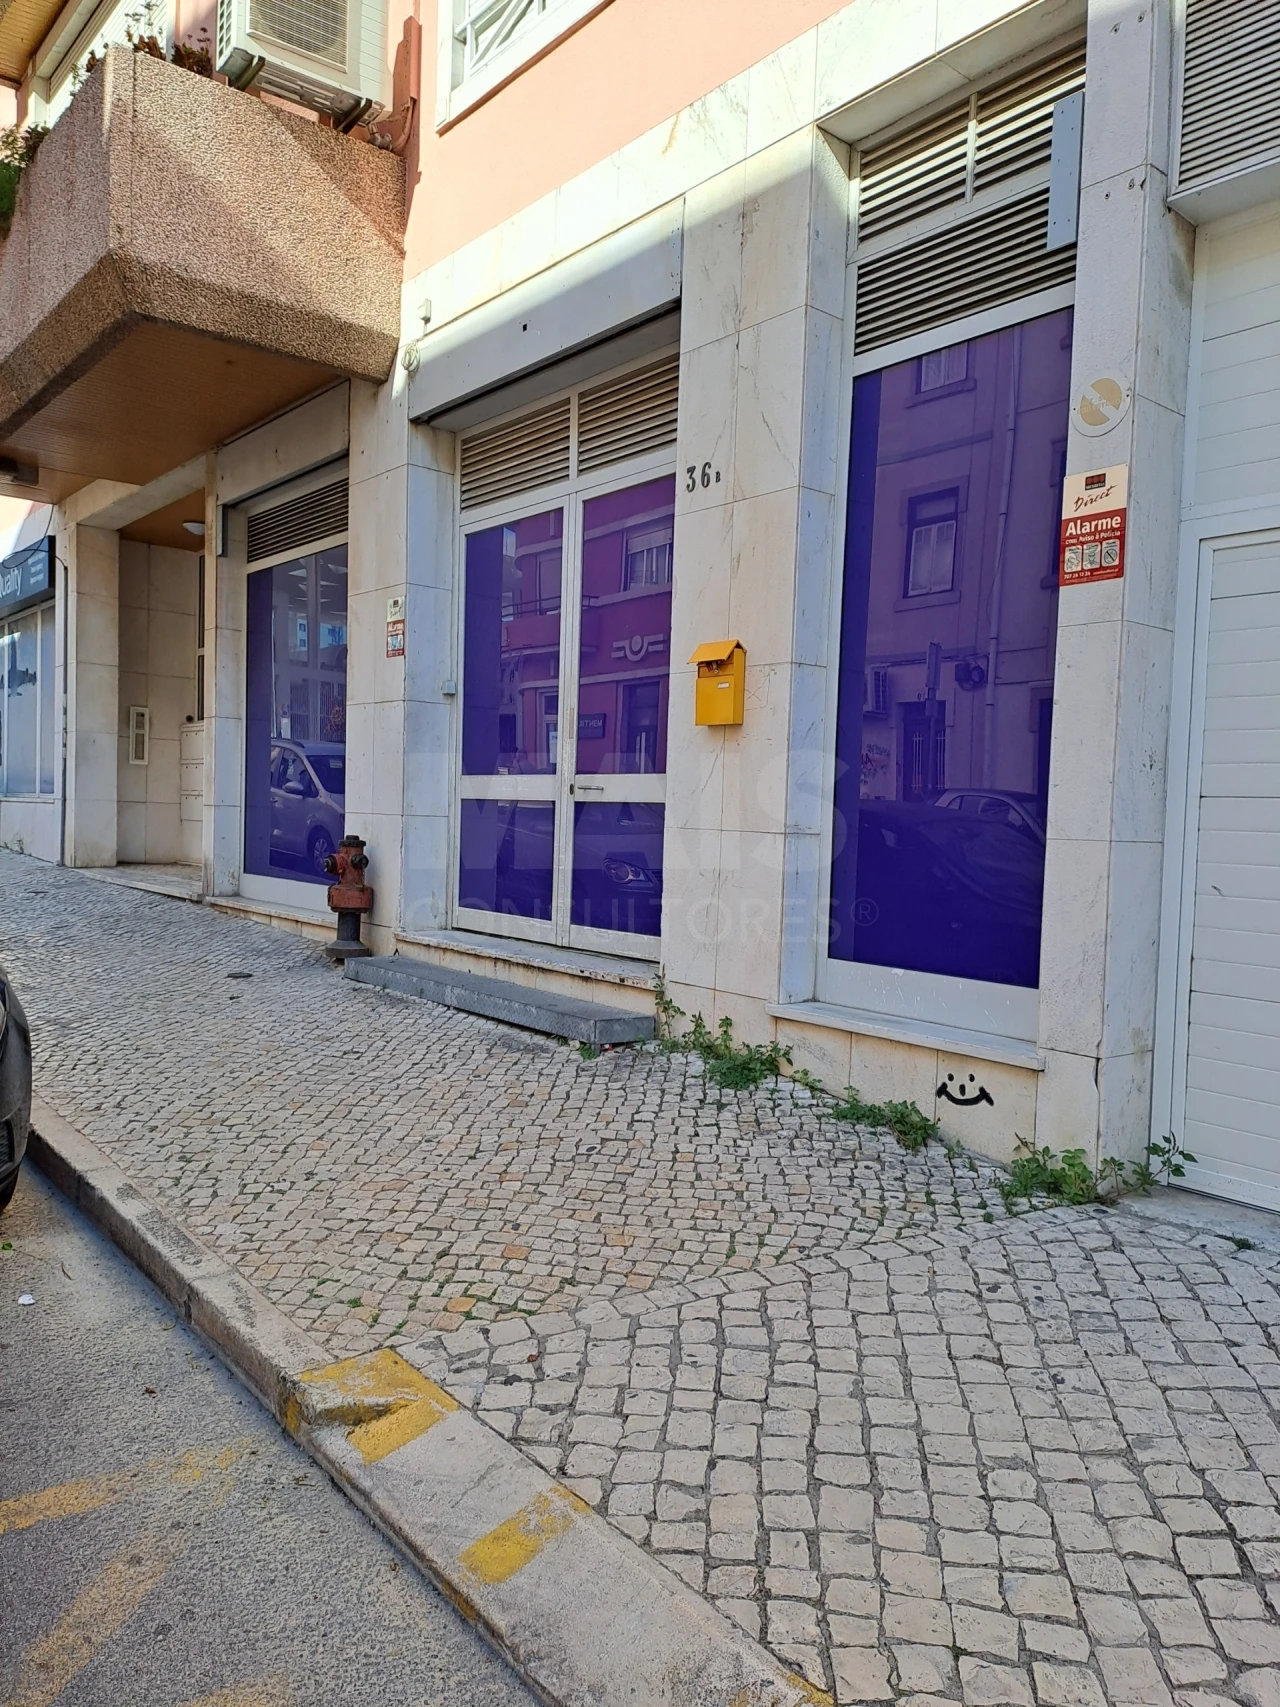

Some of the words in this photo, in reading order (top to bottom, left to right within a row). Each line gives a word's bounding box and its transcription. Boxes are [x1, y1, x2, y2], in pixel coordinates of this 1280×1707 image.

[1073, 484, 1118, 512] Direct
[1065, 515, 1122, 537] Alarme
[1078, 534, 1094, 543] Aviso
